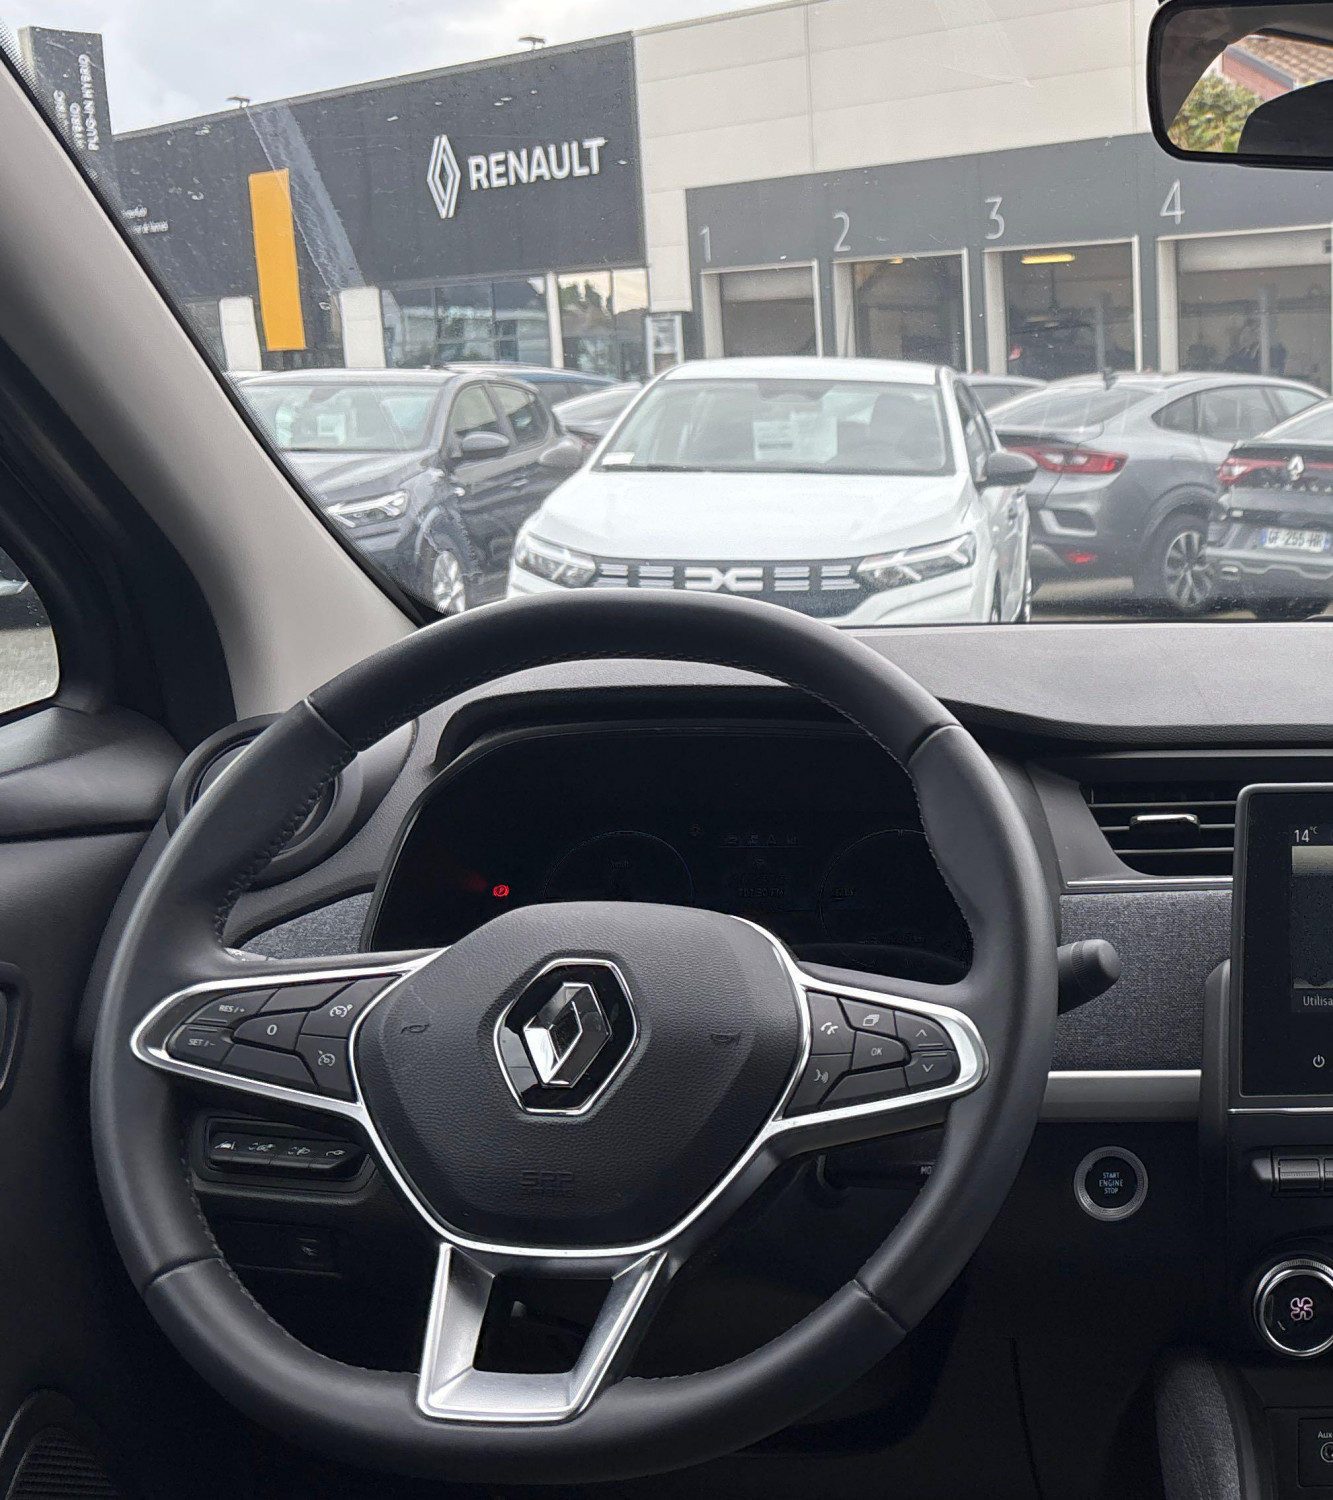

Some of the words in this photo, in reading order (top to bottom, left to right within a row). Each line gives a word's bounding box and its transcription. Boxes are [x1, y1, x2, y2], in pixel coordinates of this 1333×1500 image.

[78, 54, 95, 98] HYBRID
[82, 100, 100, 150] PLUG-IN
[467, 137, 605, 190] RENAULT
[986, 196, 1006, 239] 3
[1160, 179, 1185, 225] 4
[700, 226, 711, 263] 1
[833, 211, 852, 253] 2
[870, 1046, 883, 1057] OK
